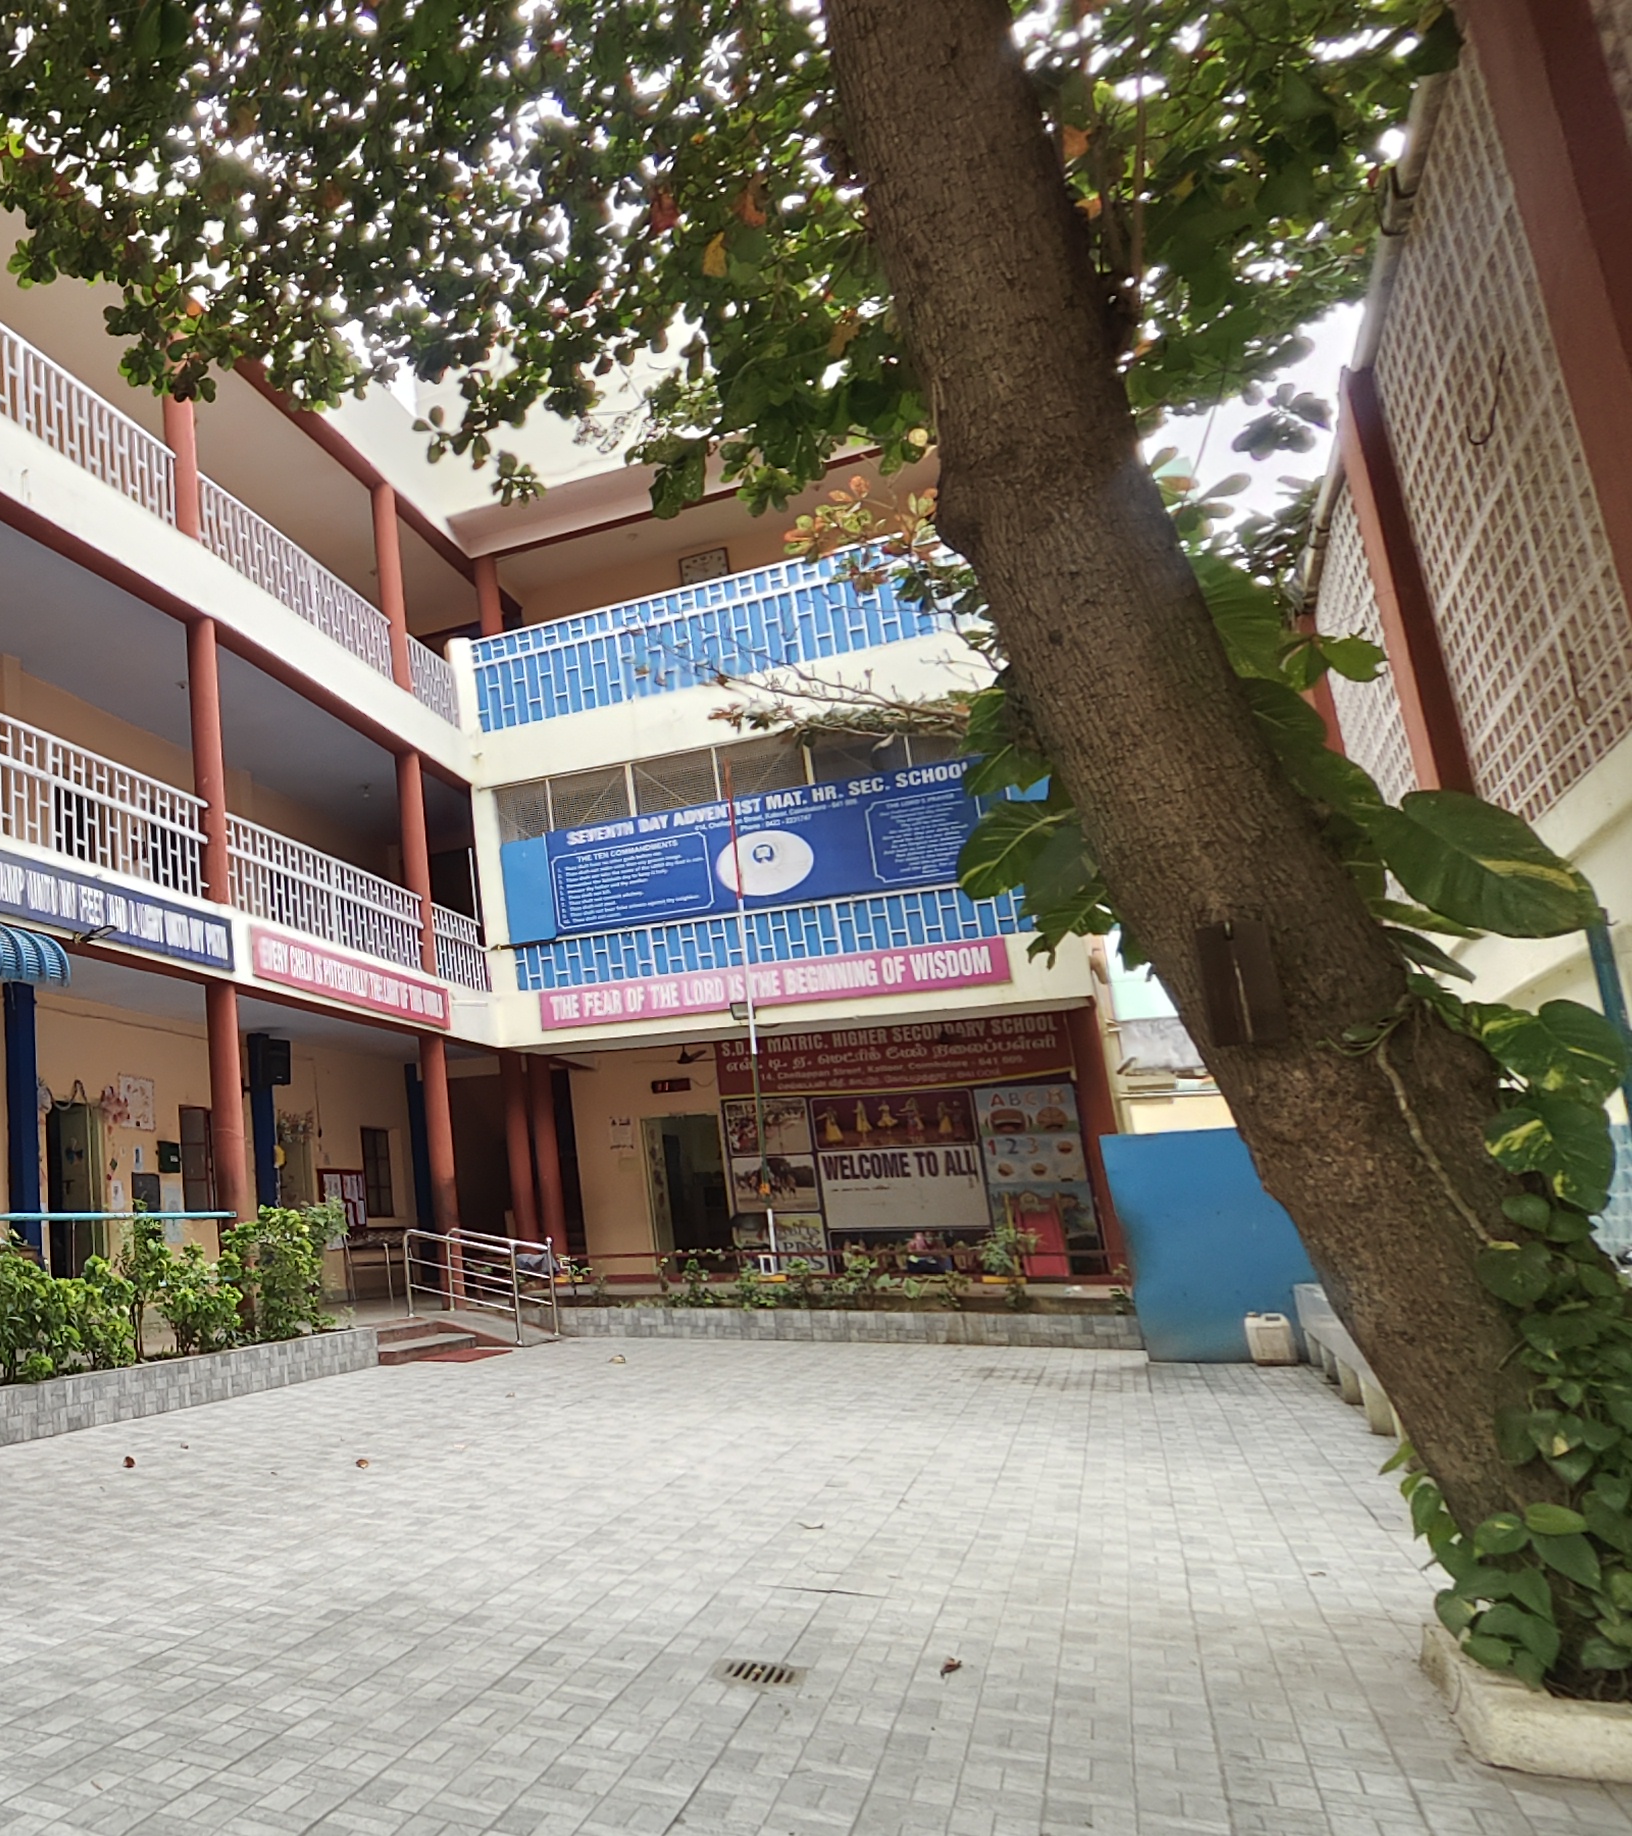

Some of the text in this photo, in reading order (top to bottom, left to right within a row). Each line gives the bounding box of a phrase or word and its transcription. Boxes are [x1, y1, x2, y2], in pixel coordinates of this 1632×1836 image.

[566, 761, 968, 846] SEVENTH DAY ADVENIST MAT. HR. SEC. SCHOO
[593, 851, 609, 860] TEN
[549, 945, 992, 1021] THE FEAR OF THE LORD IS THE BEGINNING OF WISDOM
[721, 1015, 1058, 1057] S.D.. MATRIC. HIGHER SECONDARY SCHOOL
[821, 1149, 978, 1180] WELCOME TO ALL
